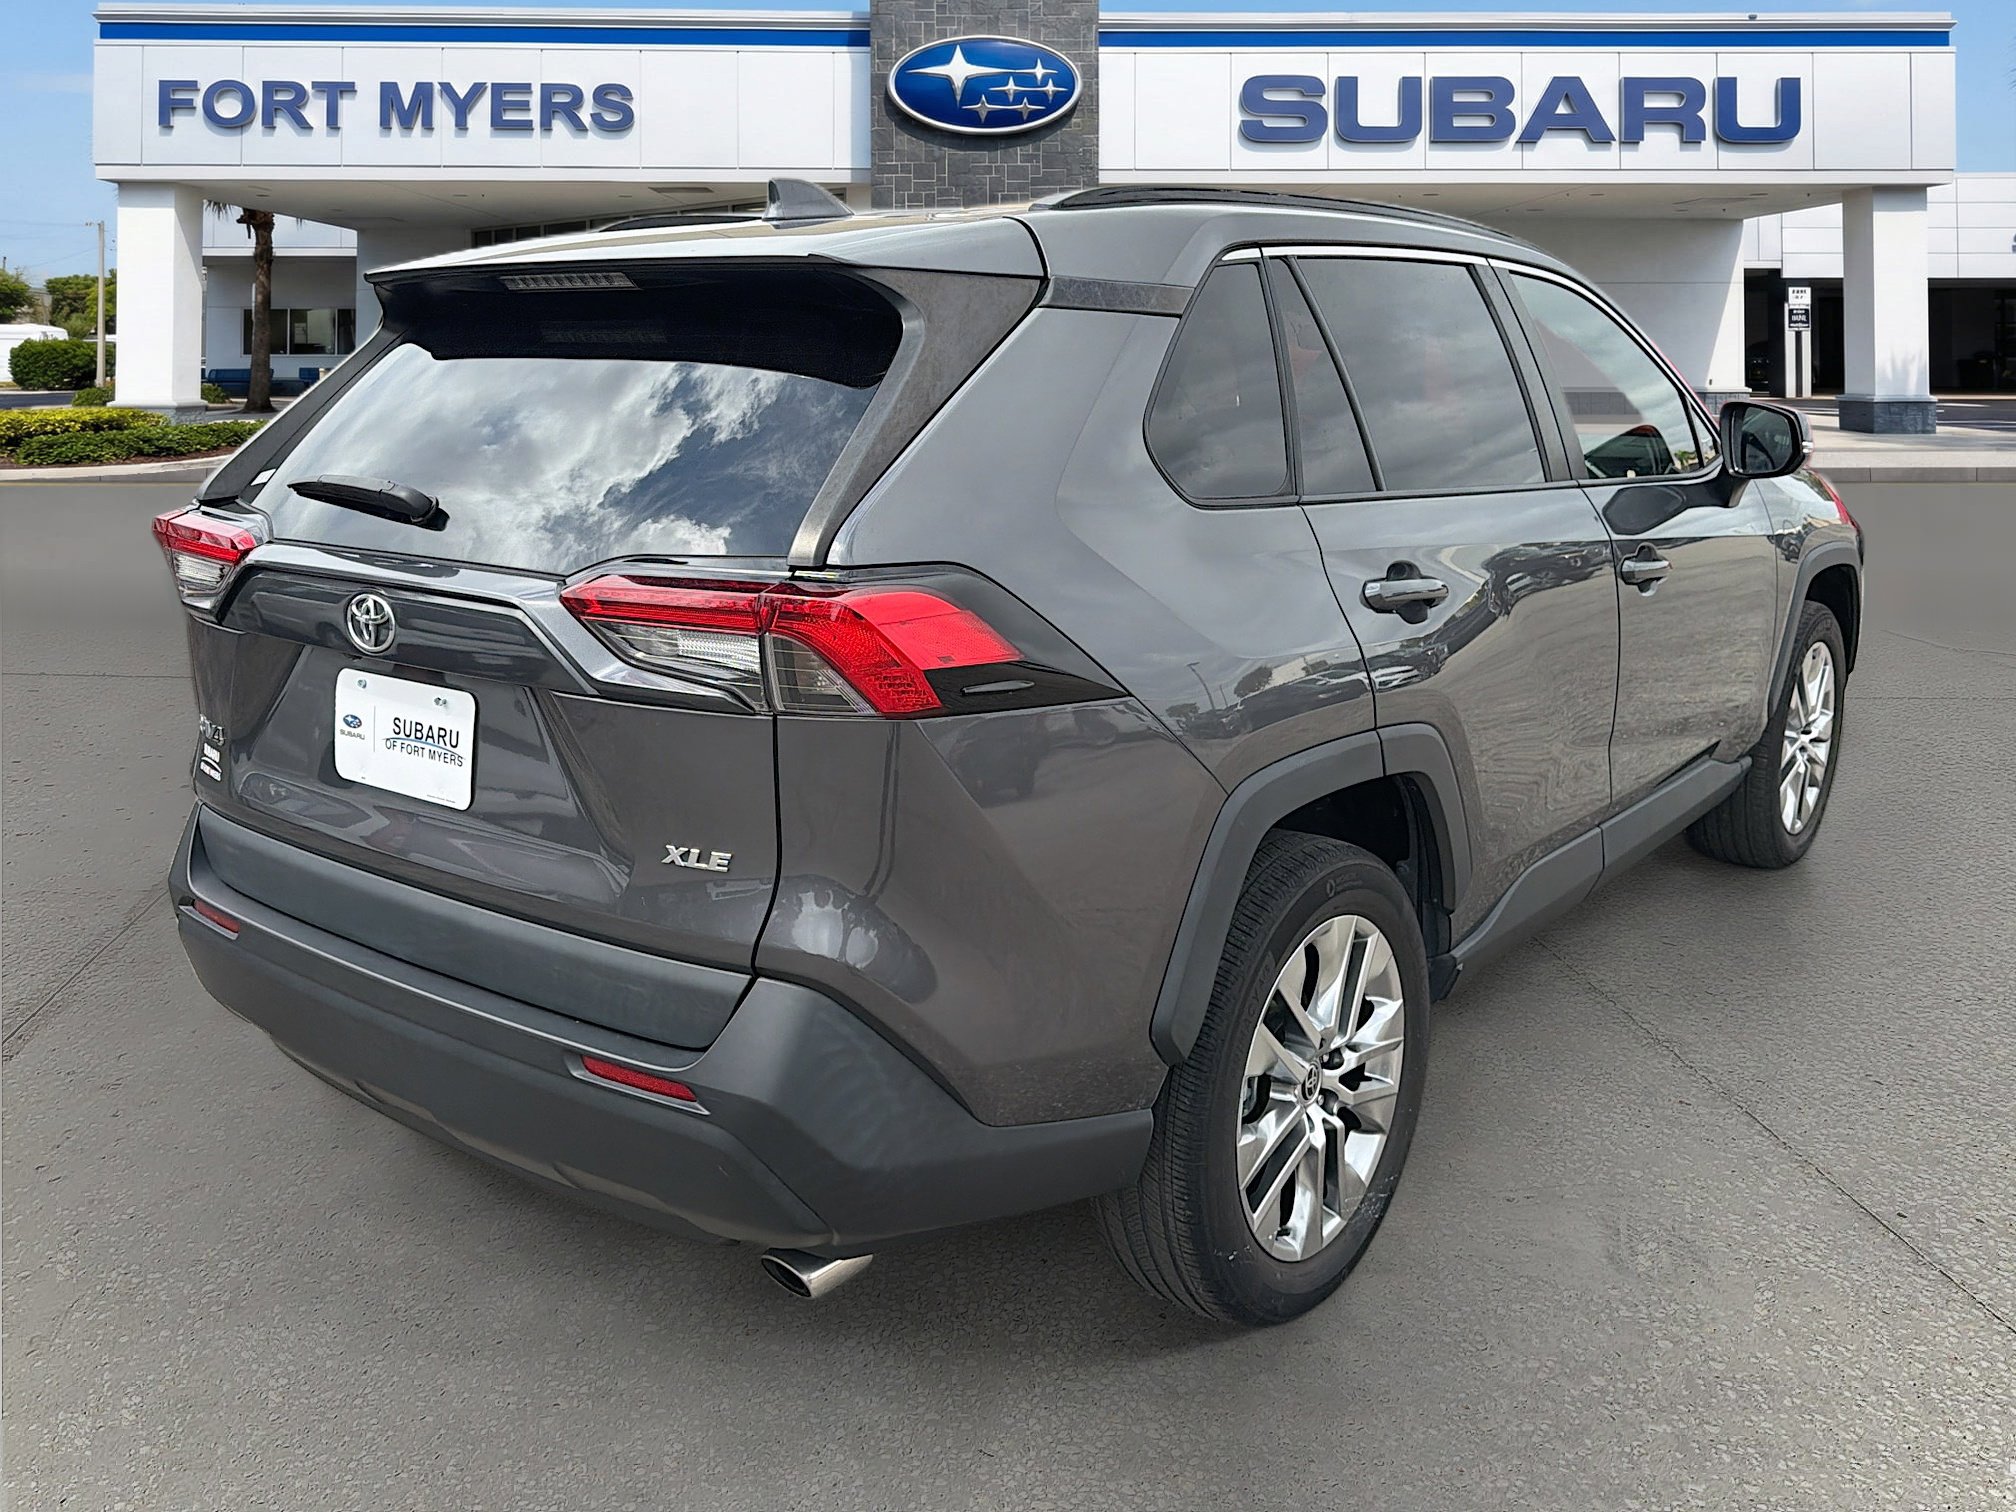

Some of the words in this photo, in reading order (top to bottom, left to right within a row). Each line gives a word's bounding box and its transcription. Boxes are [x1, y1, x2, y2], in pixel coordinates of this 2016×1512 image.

[158, 79, 357, 129] FORT
[379, 81, 636, 132] MYERS
[1239, 75, 1802, 143] SUBARU
[339, 728, 366, 741] SUBARU
[392, 716, 460, 749] SUBARU
[384, 739, 398, 751] OF
[400, 742, 425, 758] FORT
[428, 748, 464, 768] MYERS
[661, 844, 733, 873] XLE
